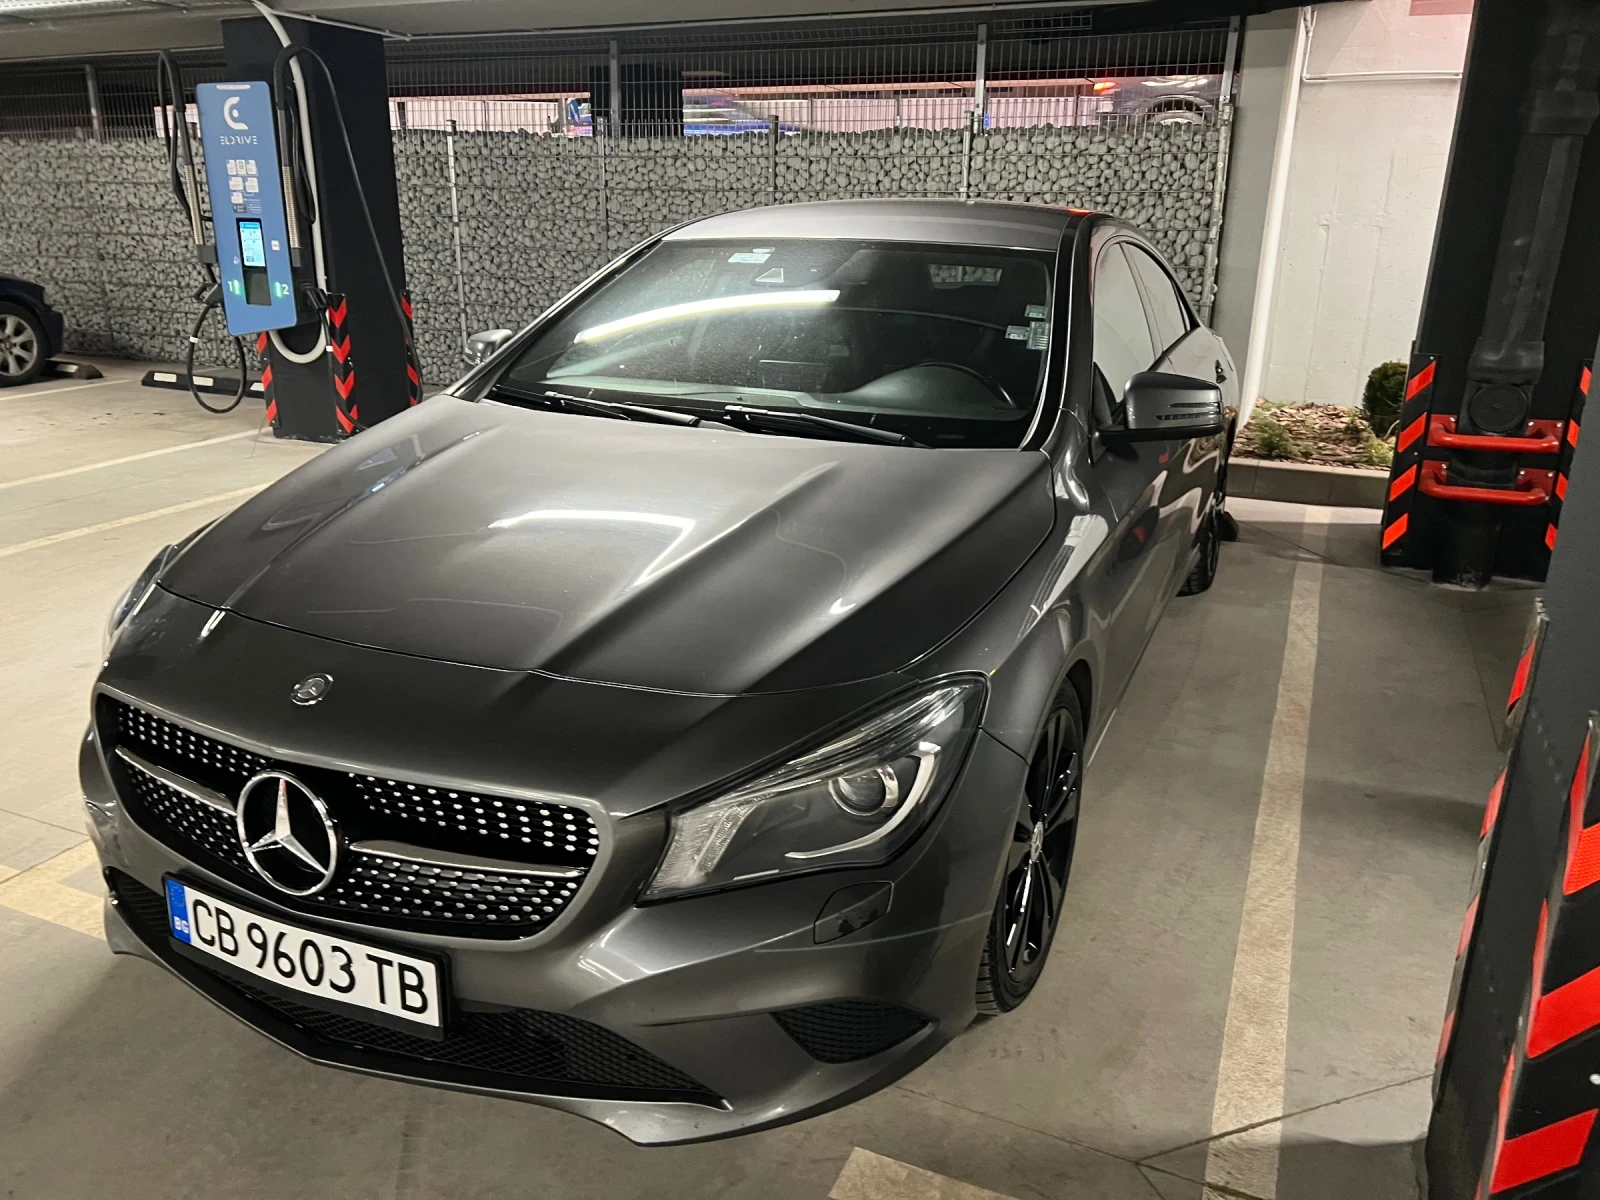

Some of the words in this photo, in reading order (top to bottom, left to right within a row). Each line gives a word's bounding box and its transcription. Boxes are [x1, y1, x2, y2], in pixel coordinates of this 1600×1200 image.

[219, 135, 258, 145] ELDRIVE
[227, 280, 233, 292] 1
[281, 283, 290, 295] 2
[173, 915, 189, 934] BG
[193, 898, 239, 957] CB
[247, 922, 356, 994] 9603
[365, 953, 429, 1015] TB
